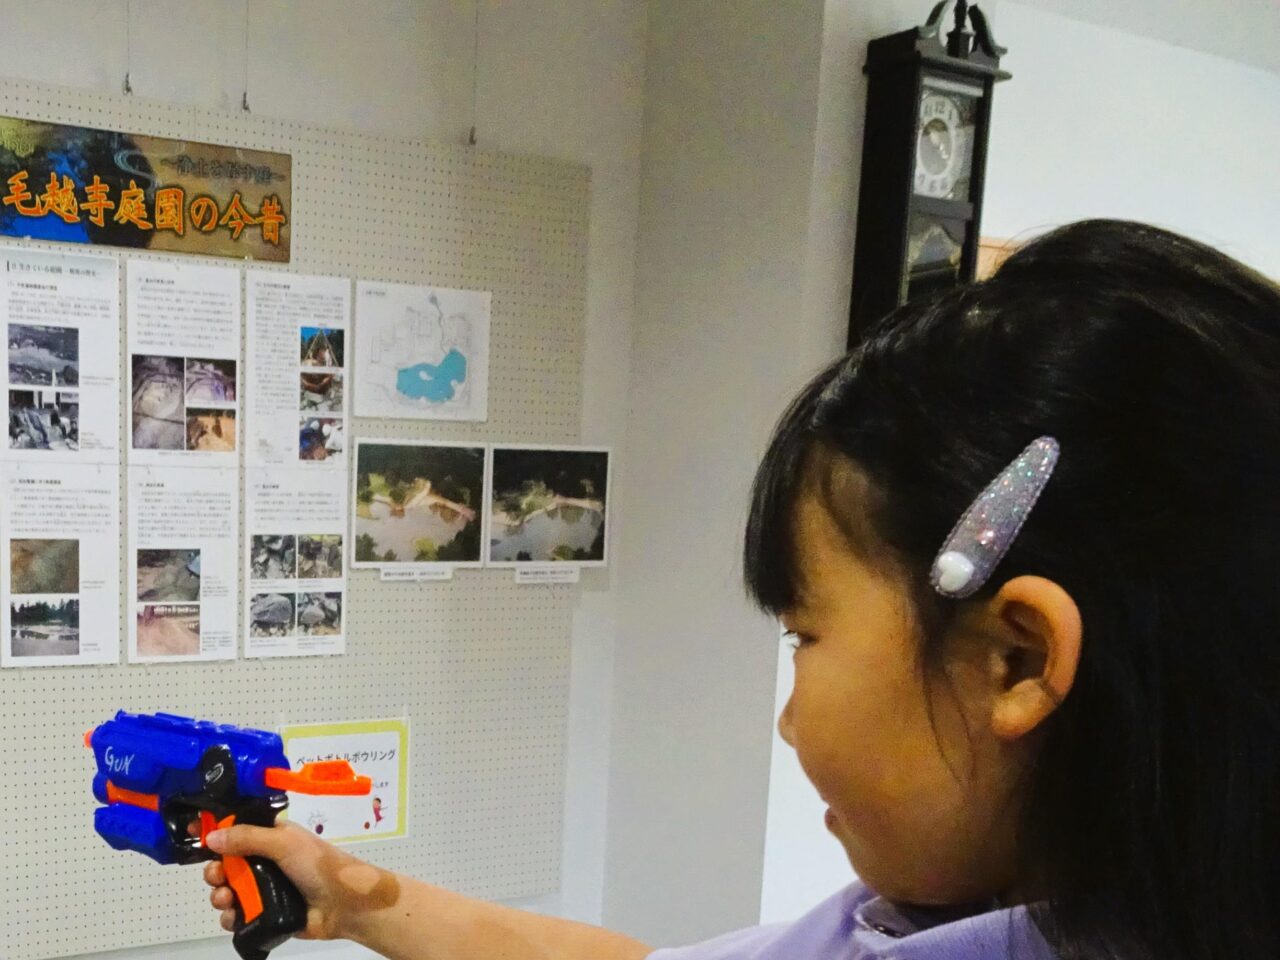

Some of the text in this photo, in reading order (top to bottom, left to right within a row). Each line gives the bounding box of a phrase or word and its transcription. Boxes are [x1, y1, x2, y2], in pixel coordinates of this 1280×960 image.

[3, 171, 286, 246] 毛越寺庭園の今昔
